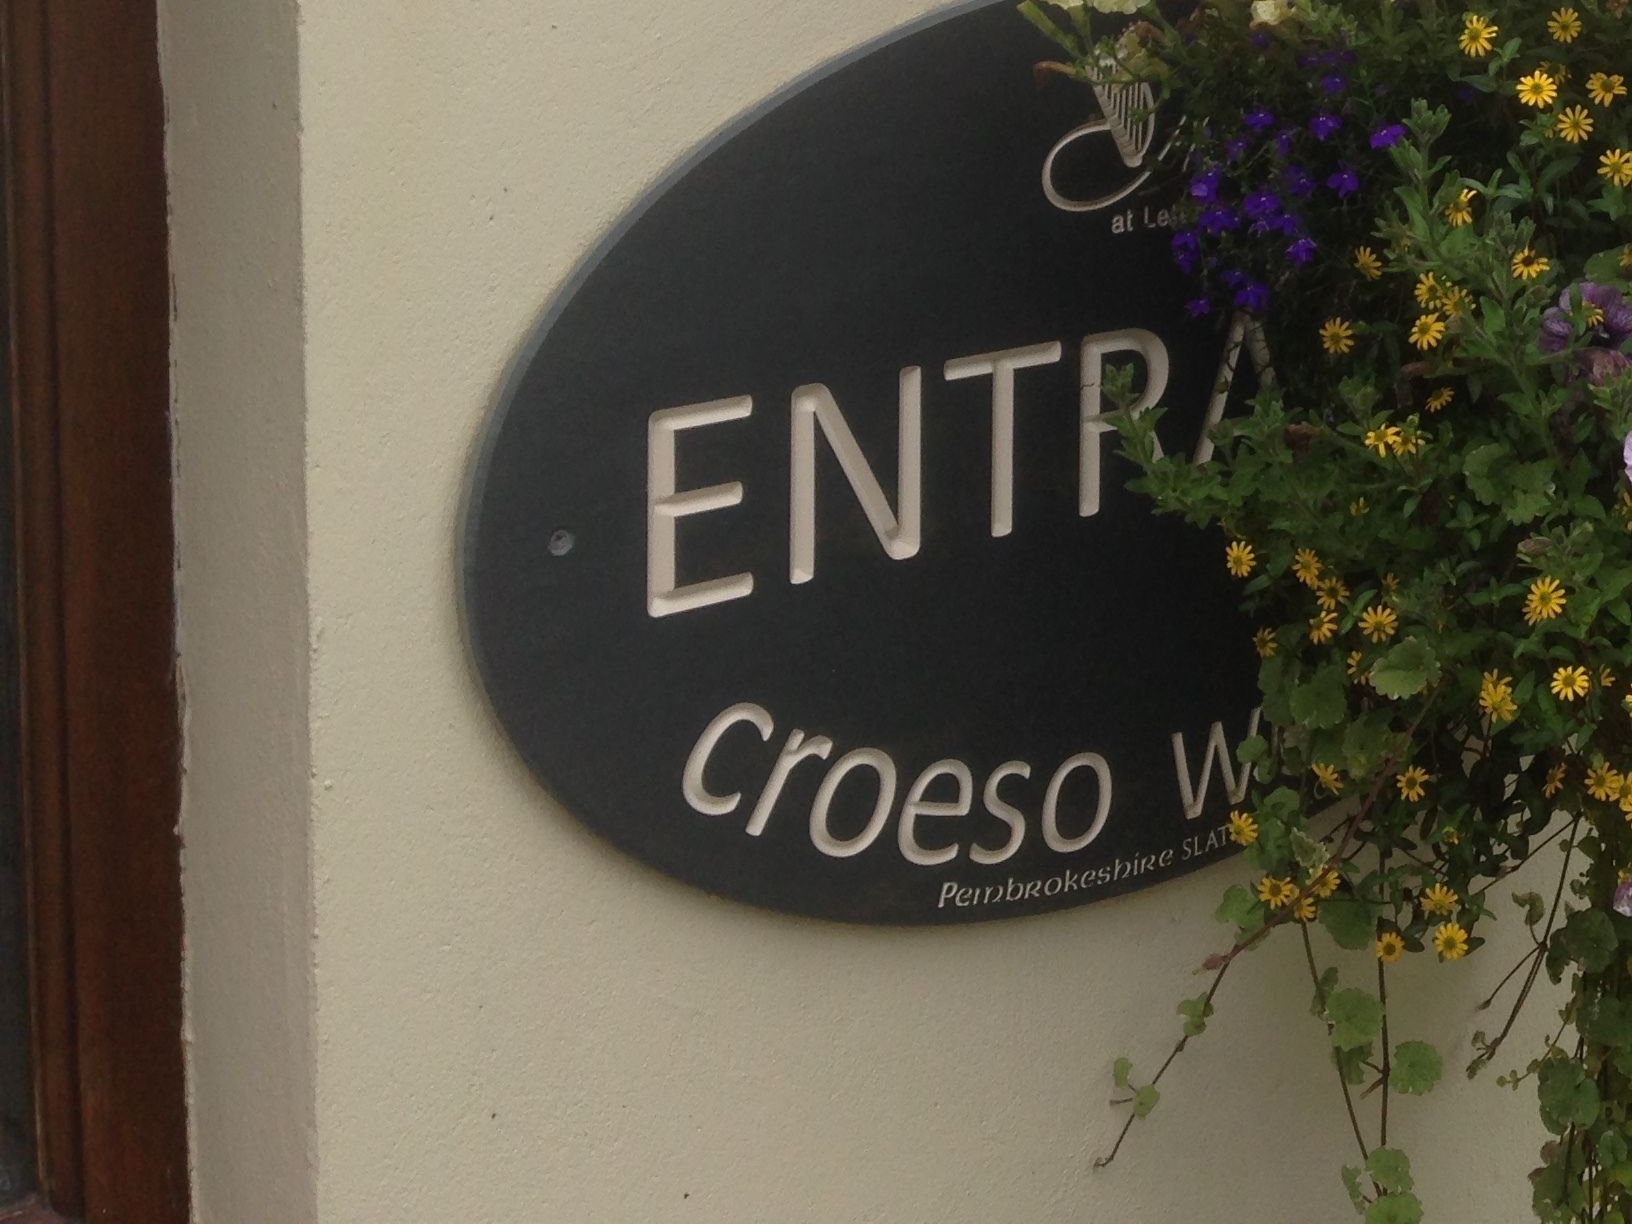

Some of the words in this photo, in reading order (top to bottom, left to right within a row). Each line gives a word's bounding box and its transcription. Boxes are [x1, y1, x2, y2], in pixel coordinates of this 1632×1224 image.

[1110, 208, 1135, 235] at
[646, 308, 1284, 619] ENTRA
[937, 847, 1175, 909] Pembrokeshire
[1181, 824, 1233, 862] SLAT
